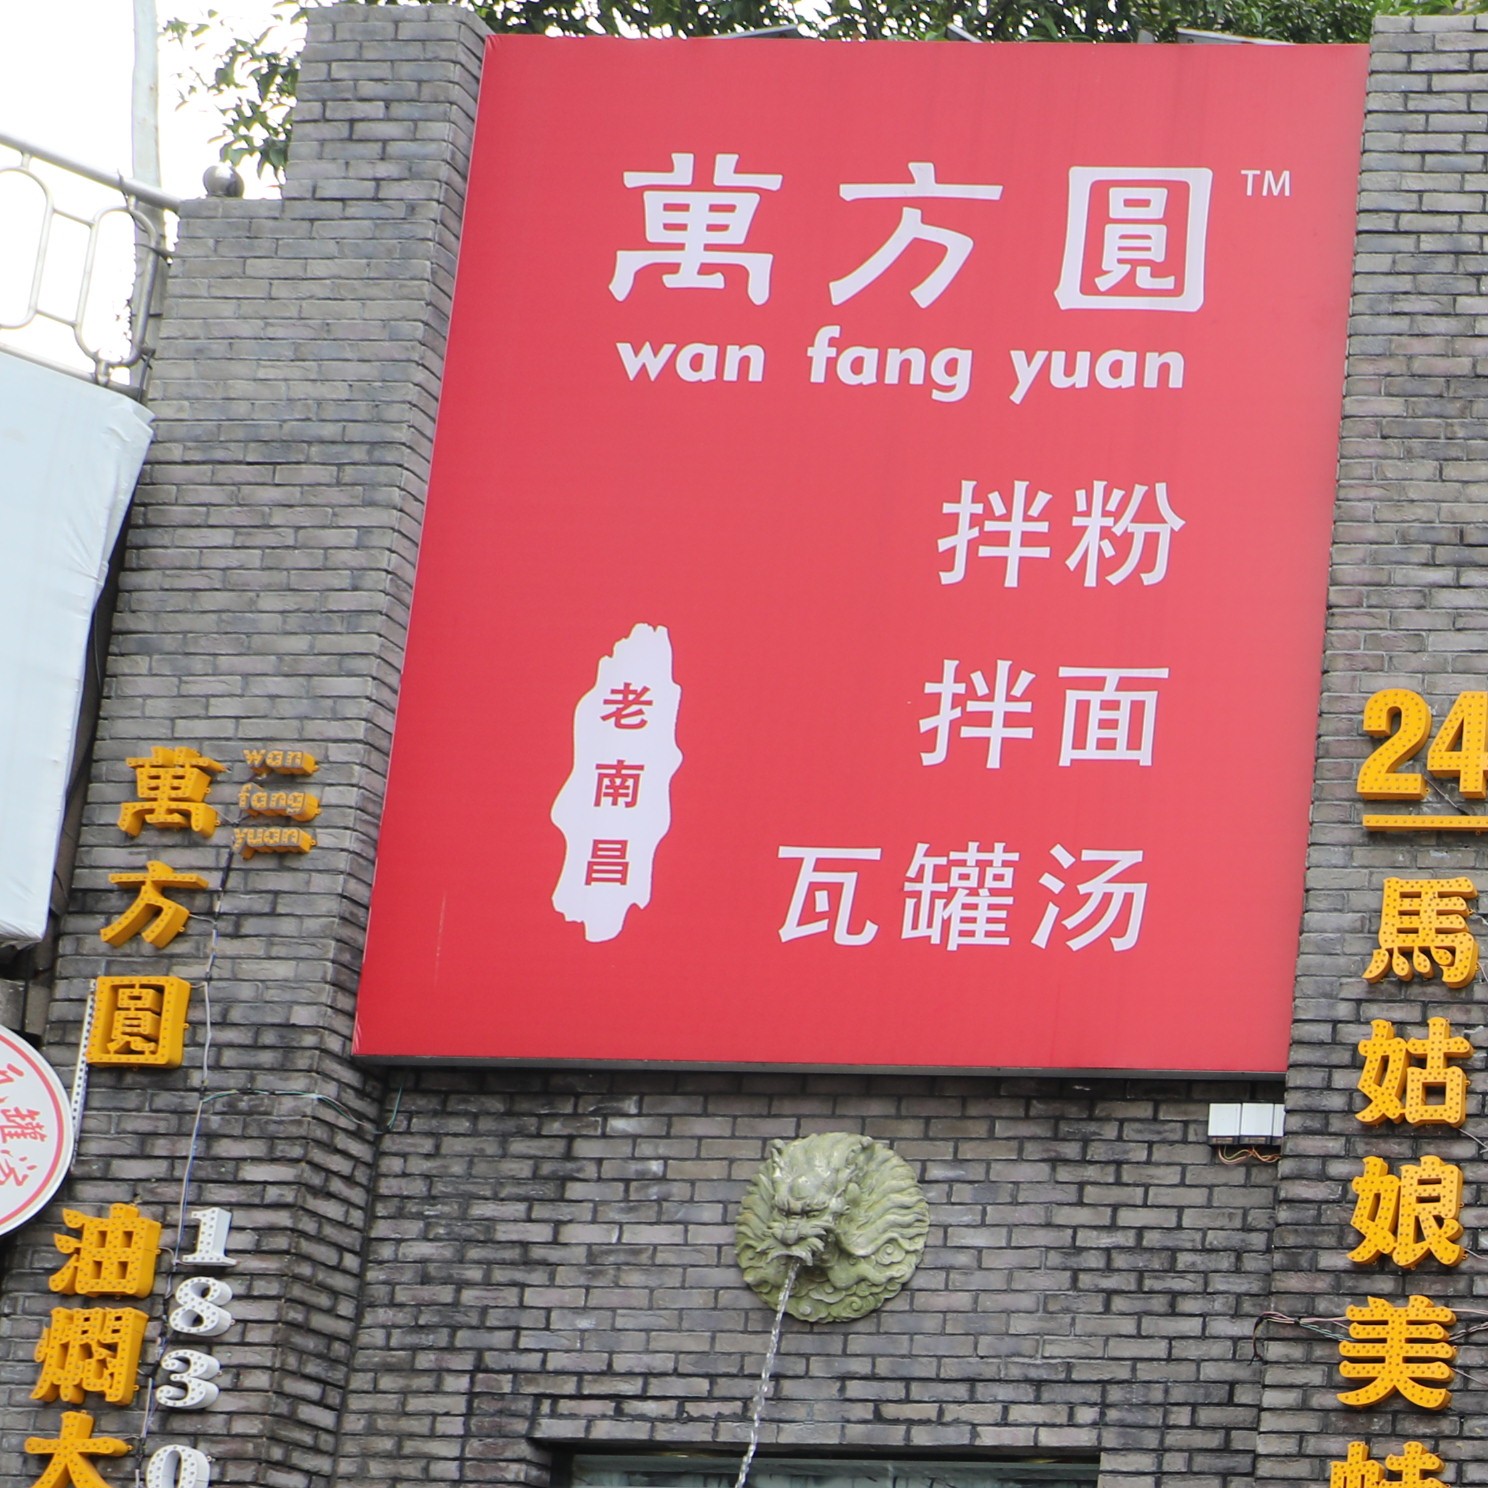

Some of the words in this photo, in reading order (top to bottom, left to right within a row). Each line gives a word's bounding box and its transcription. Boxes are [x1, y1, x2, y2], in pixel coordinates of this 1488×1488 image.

[609, 152, 1213, 312] 萬方圓
[1241, 169, 1293, 197] TM
[616, 340, 765, 384] wan
[807, 325, 972, 402] fang
[1010, 347, 1185, 405] yuan
[938, 480, 1186, 587] 拌粉
[243, 749, 310, 770] wan
[919, 660, 1169, 768] 拌面
[238, 782, 312, 817] fang
[584, 683, 653, 886] 老南昌
[232, 828, 307, 856] yuan
[86, 746, 226, 1068] 萬方圓
[777, 843, 1148, 951] 瓦罐汤
